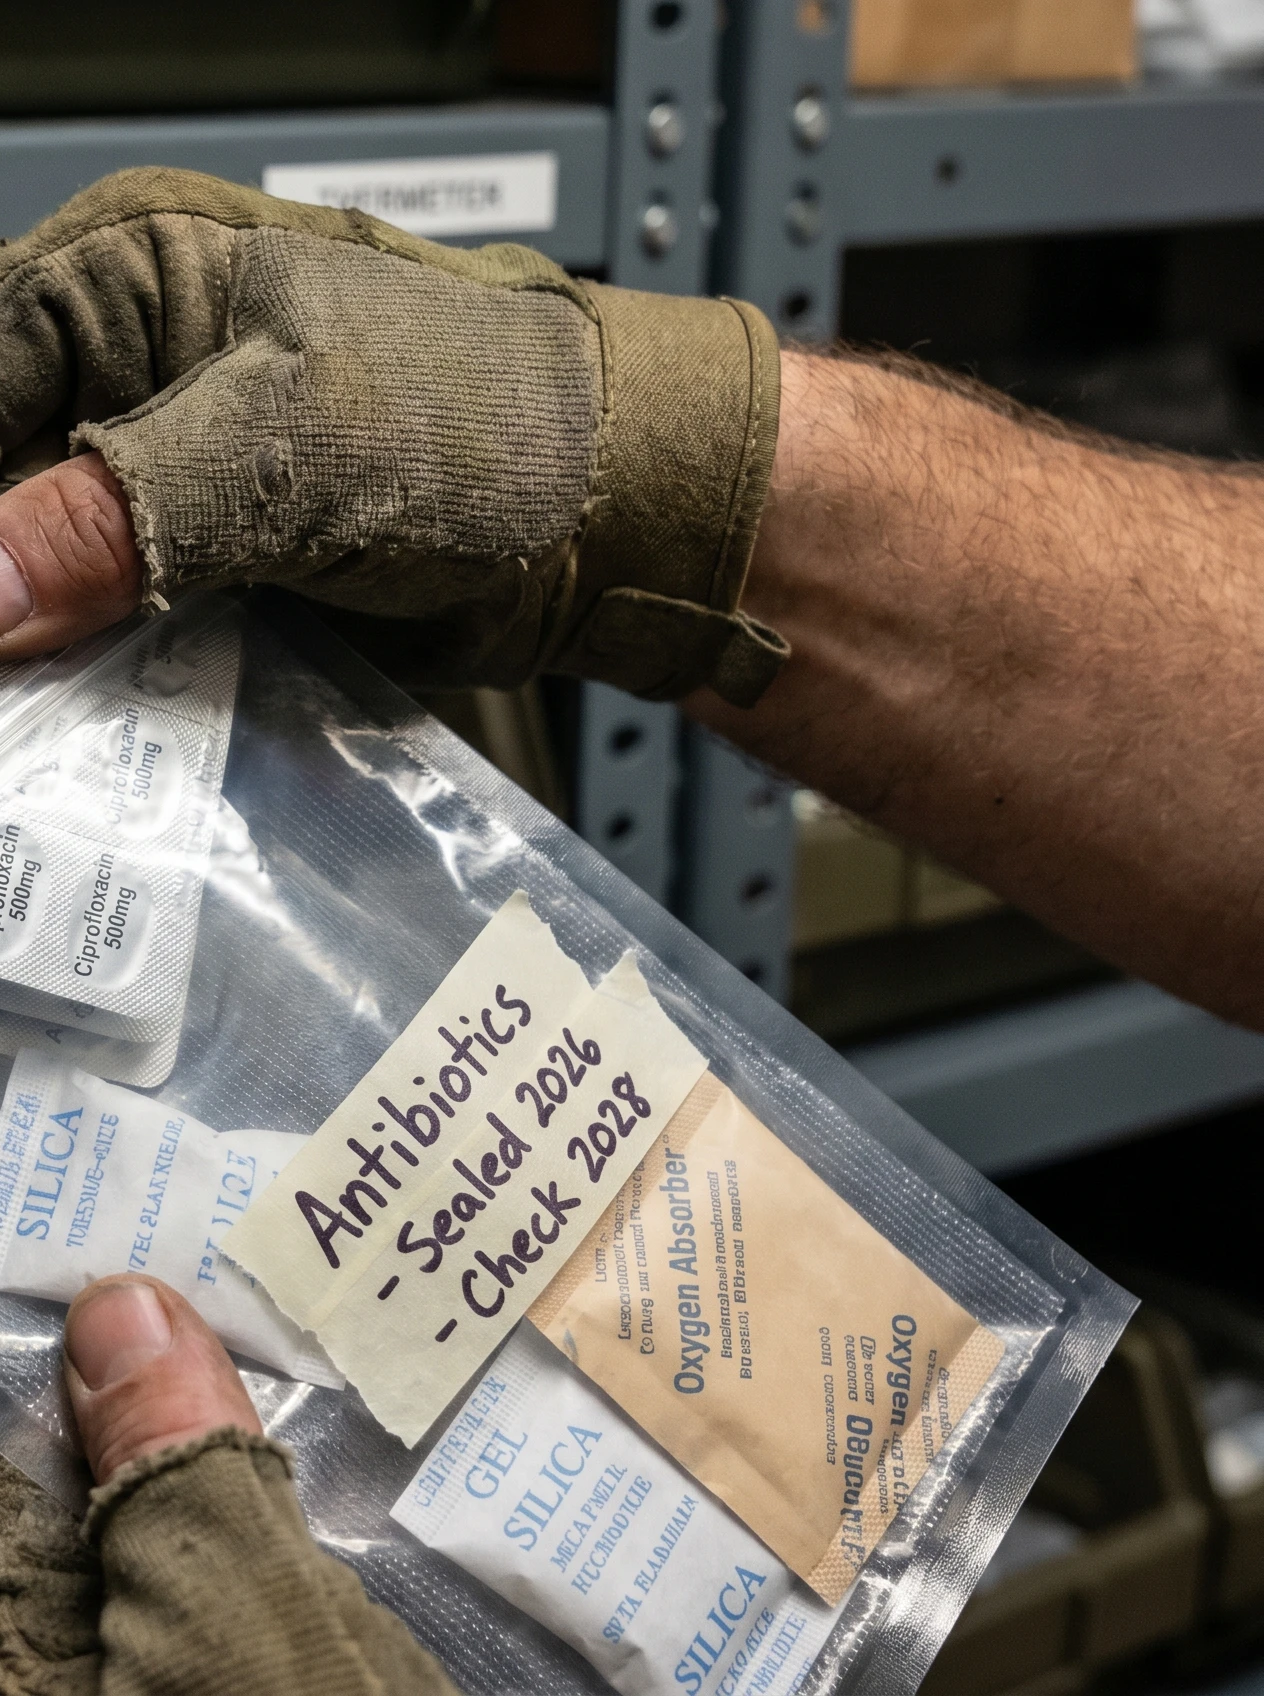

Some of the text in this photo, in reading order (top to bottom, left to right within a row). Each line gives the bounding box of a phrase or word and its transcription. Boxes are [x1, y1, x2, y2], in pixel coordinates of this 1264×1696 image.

[132, 741, 162, 800] 500mg
[9, 859, 42, 921] 500mg
[74, 853, 114, 977] Ciprofloxacin
[105, 887, 137, 950] 500mg
[16, 1106, 84, 1240] SILICA
[294, 984, 531, 1269] Antibiotics
[397, 1112, 532, 1273] Sealed
[516, 1027, 602, 1128] 2026
[461, 1181, 581, 1318] Check
[567, 1071, 651, 1183] 2028
[660, 1148, 711, 1394] Oxygen Absorber
[886, 1314, 917, 1426] Oxygen
[464, 1428, 528, 1499] GEL
[503, 1425, 603, 1551] SILICA
[674, 1564, 767, 1696] SILICA
